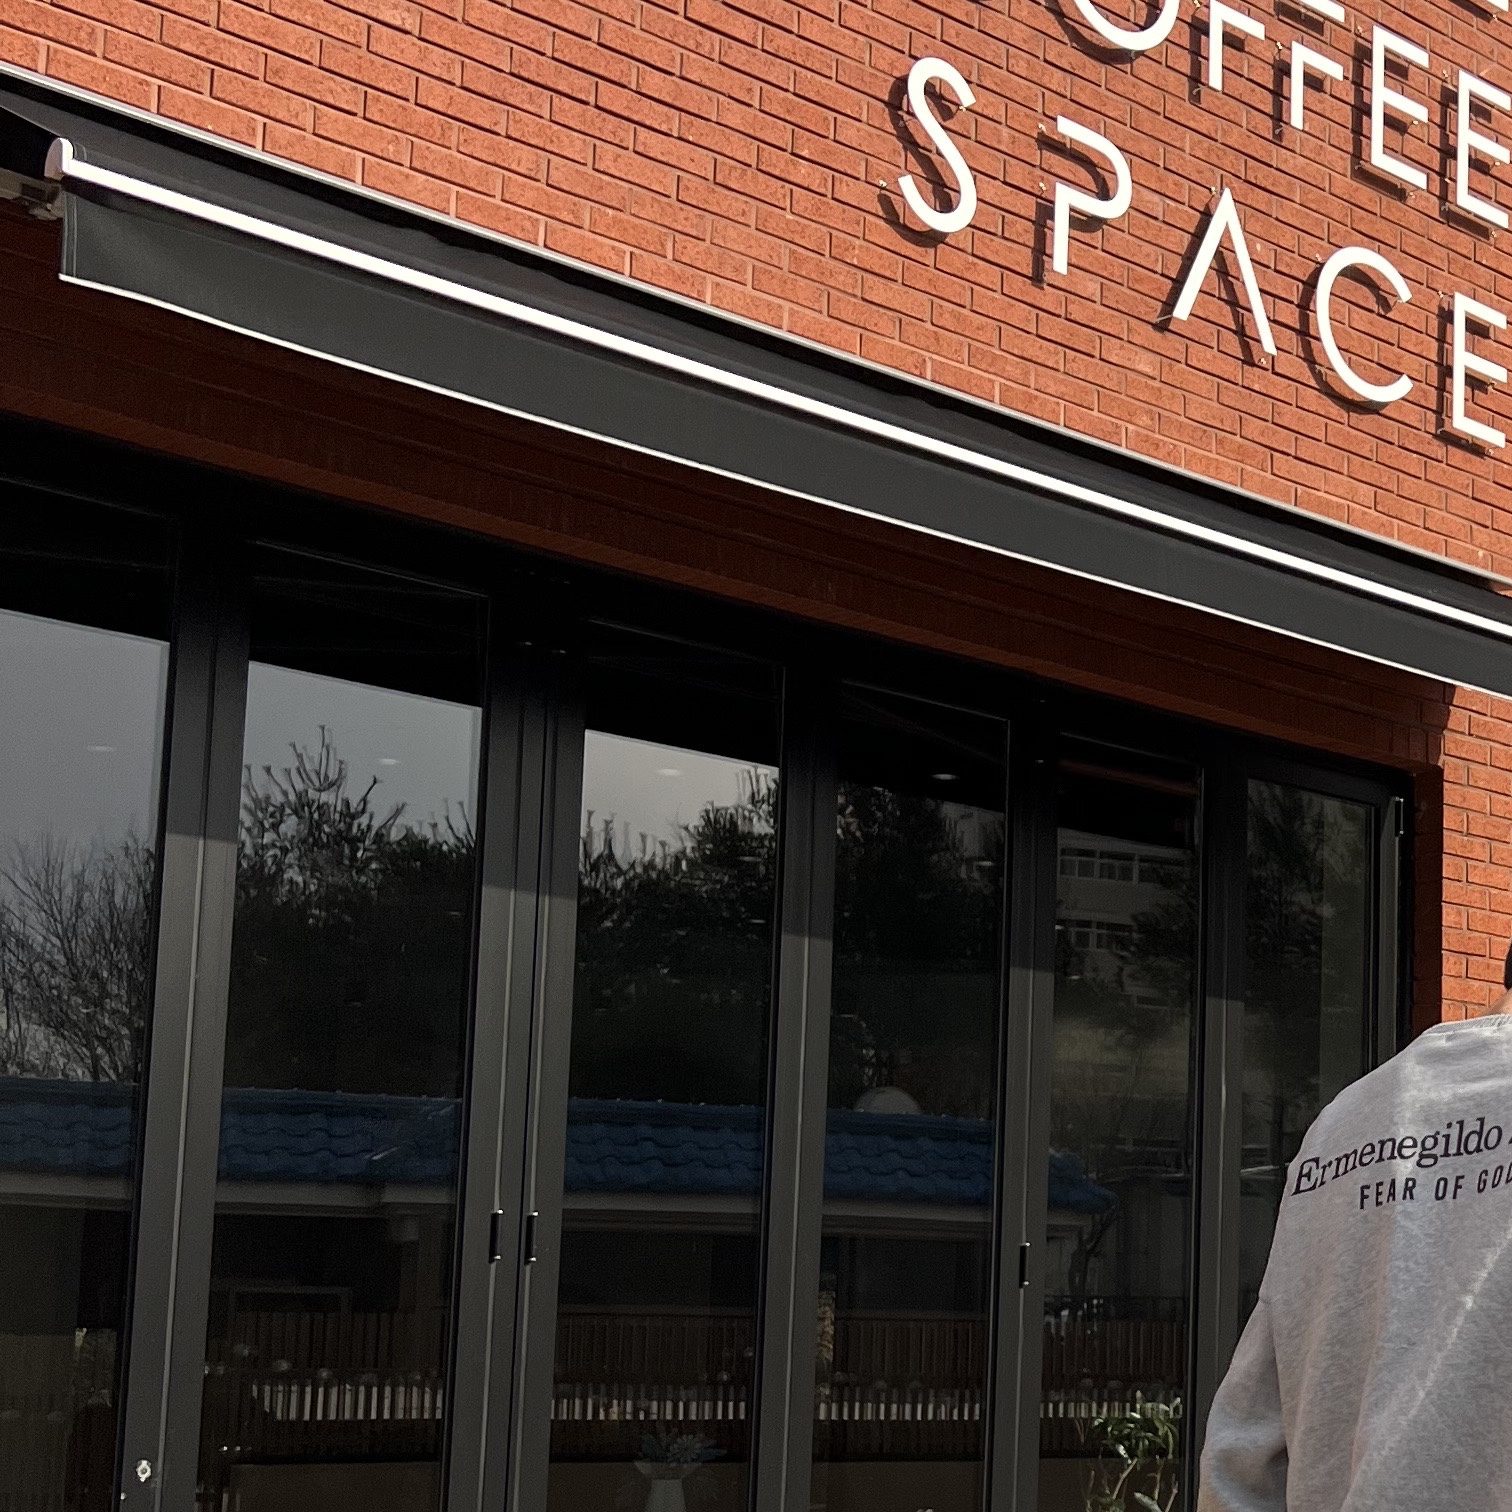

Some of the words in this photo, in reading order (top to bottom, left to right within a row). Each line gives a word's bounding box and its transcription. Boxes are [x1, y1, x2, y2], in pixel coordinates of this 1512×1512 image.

[898, 57, 1507, 448] SPACE
[1291, 1118, 1503, 1196] Ermenegildo
[1359, 1177, 1415, 1210] FEAR
[1434, 1174, 1465, 1201] OF
